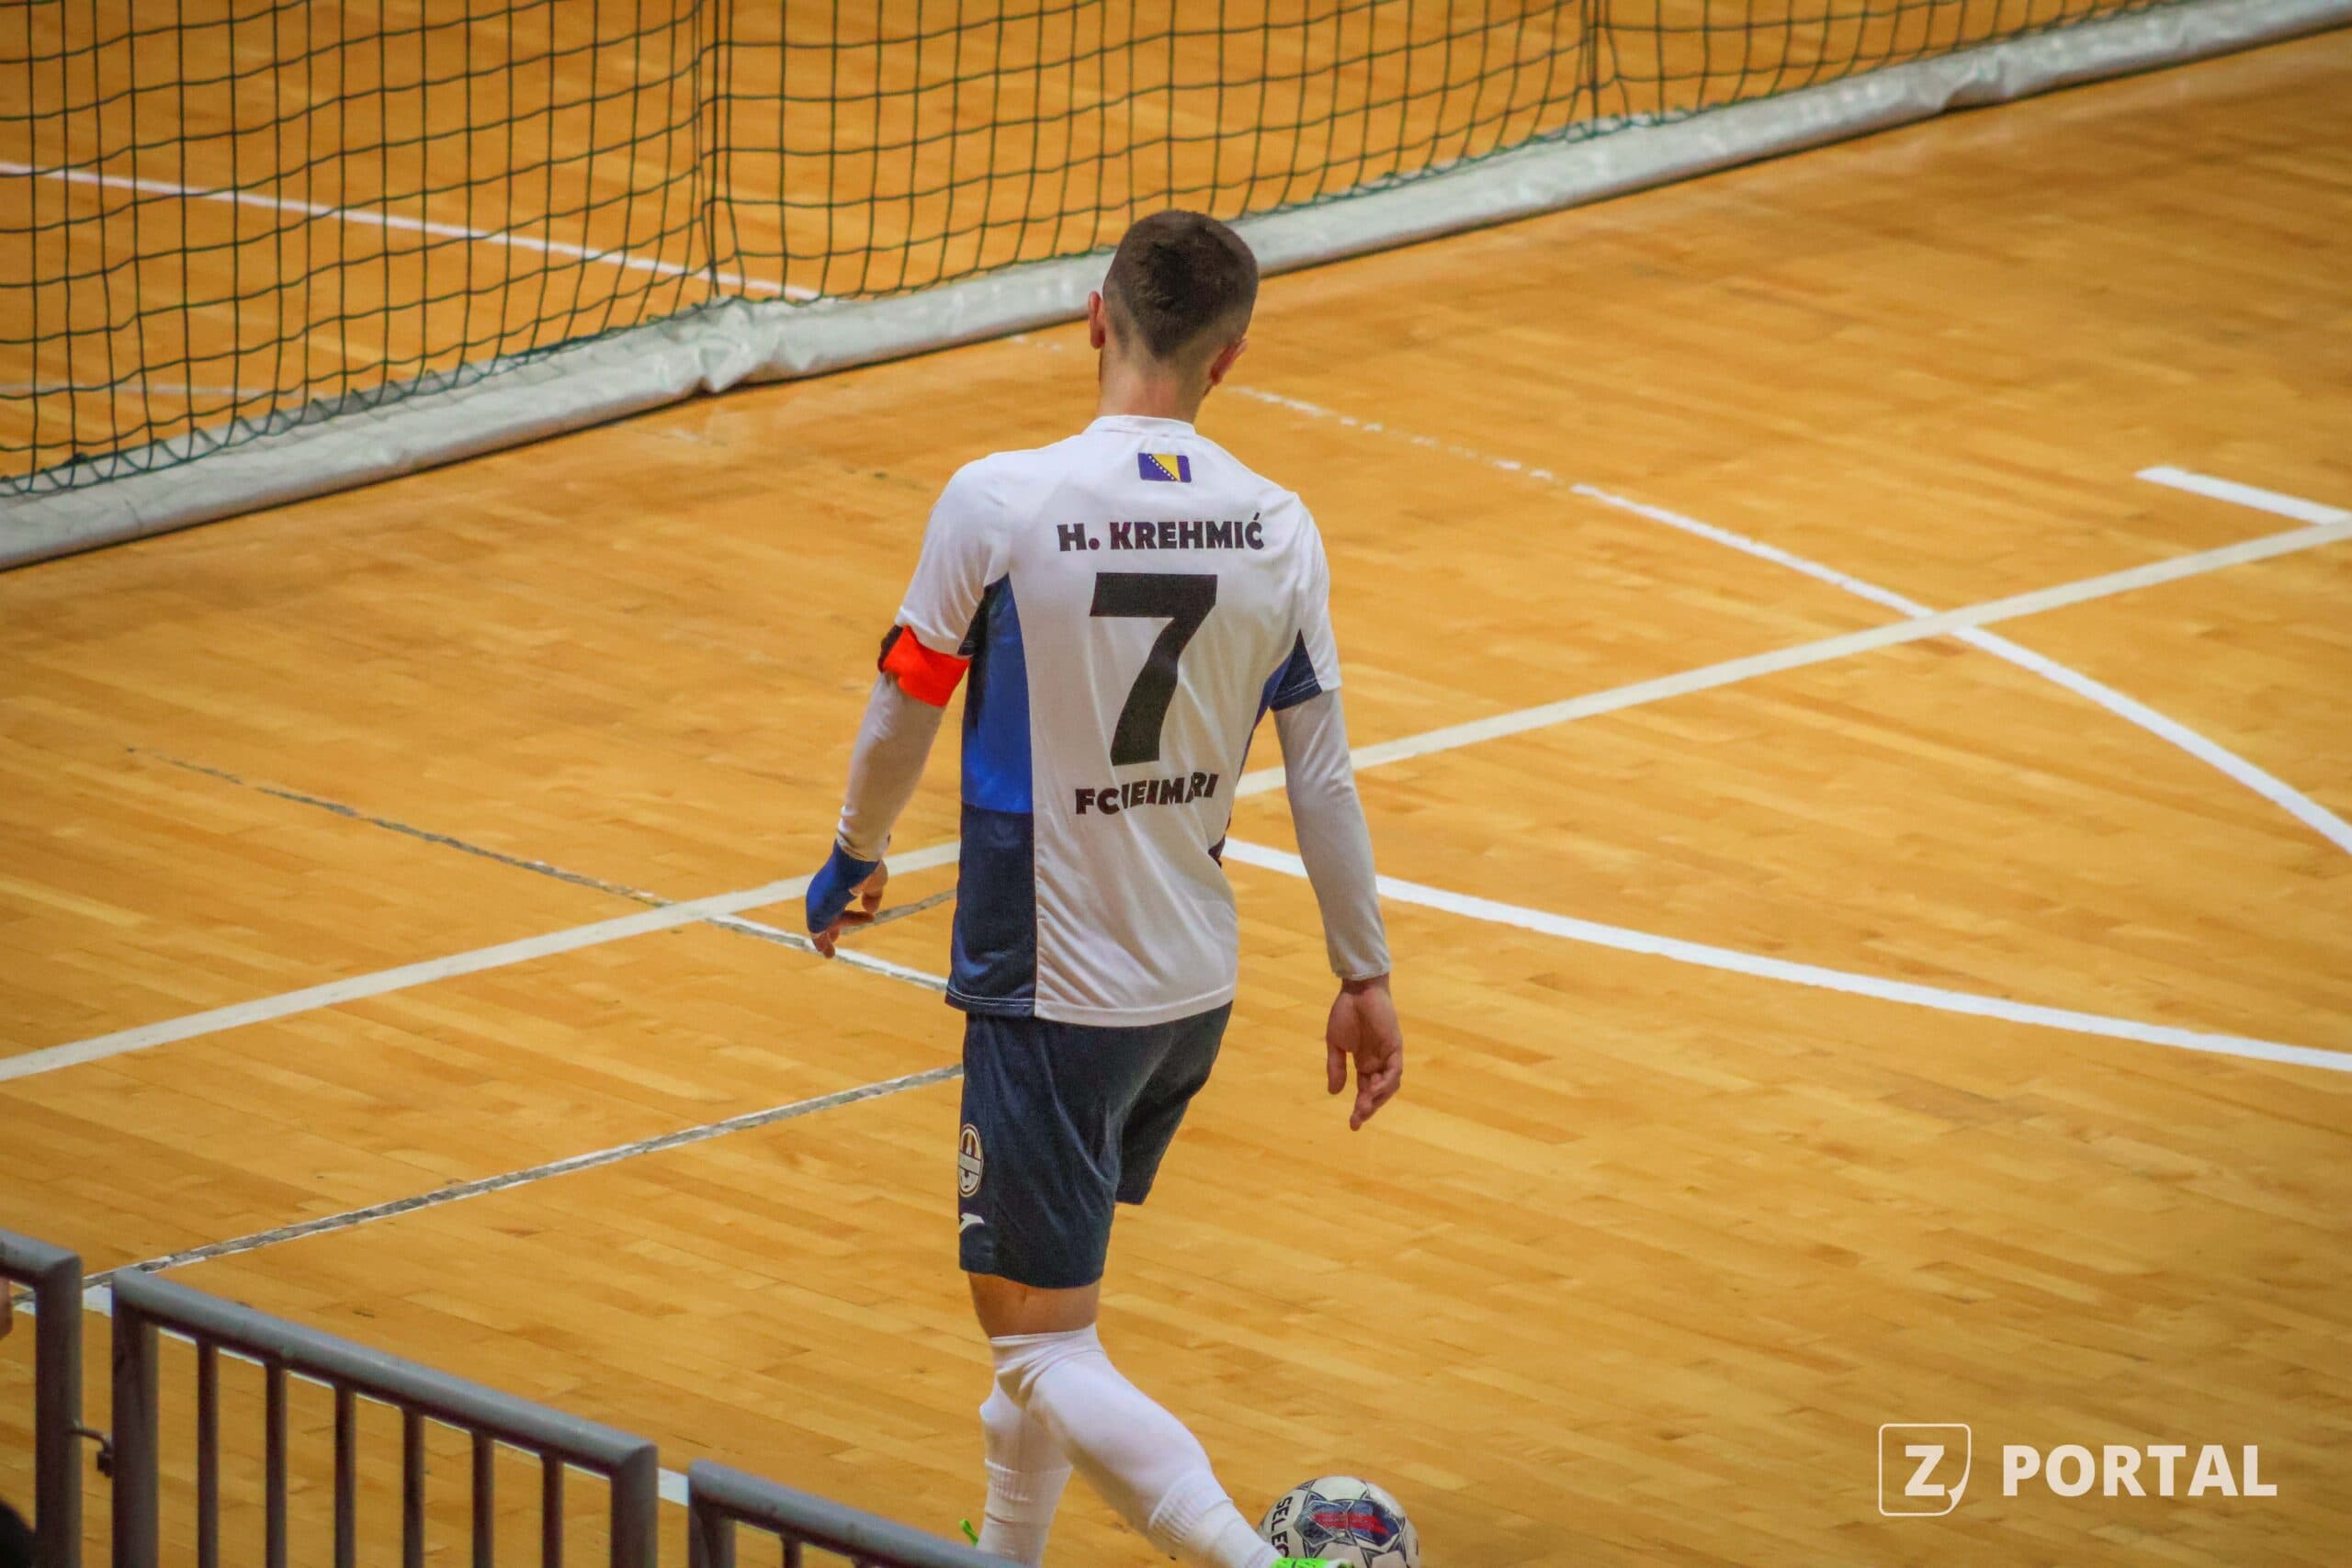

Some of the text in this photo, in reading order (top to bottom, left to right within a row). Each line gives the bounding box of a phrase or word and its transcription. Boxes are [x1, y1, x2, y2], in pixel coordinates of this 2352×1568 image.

[1057, 513, 1264, 551] H. KREHMIĆ
[1090, 572, 1217, 766] 7
